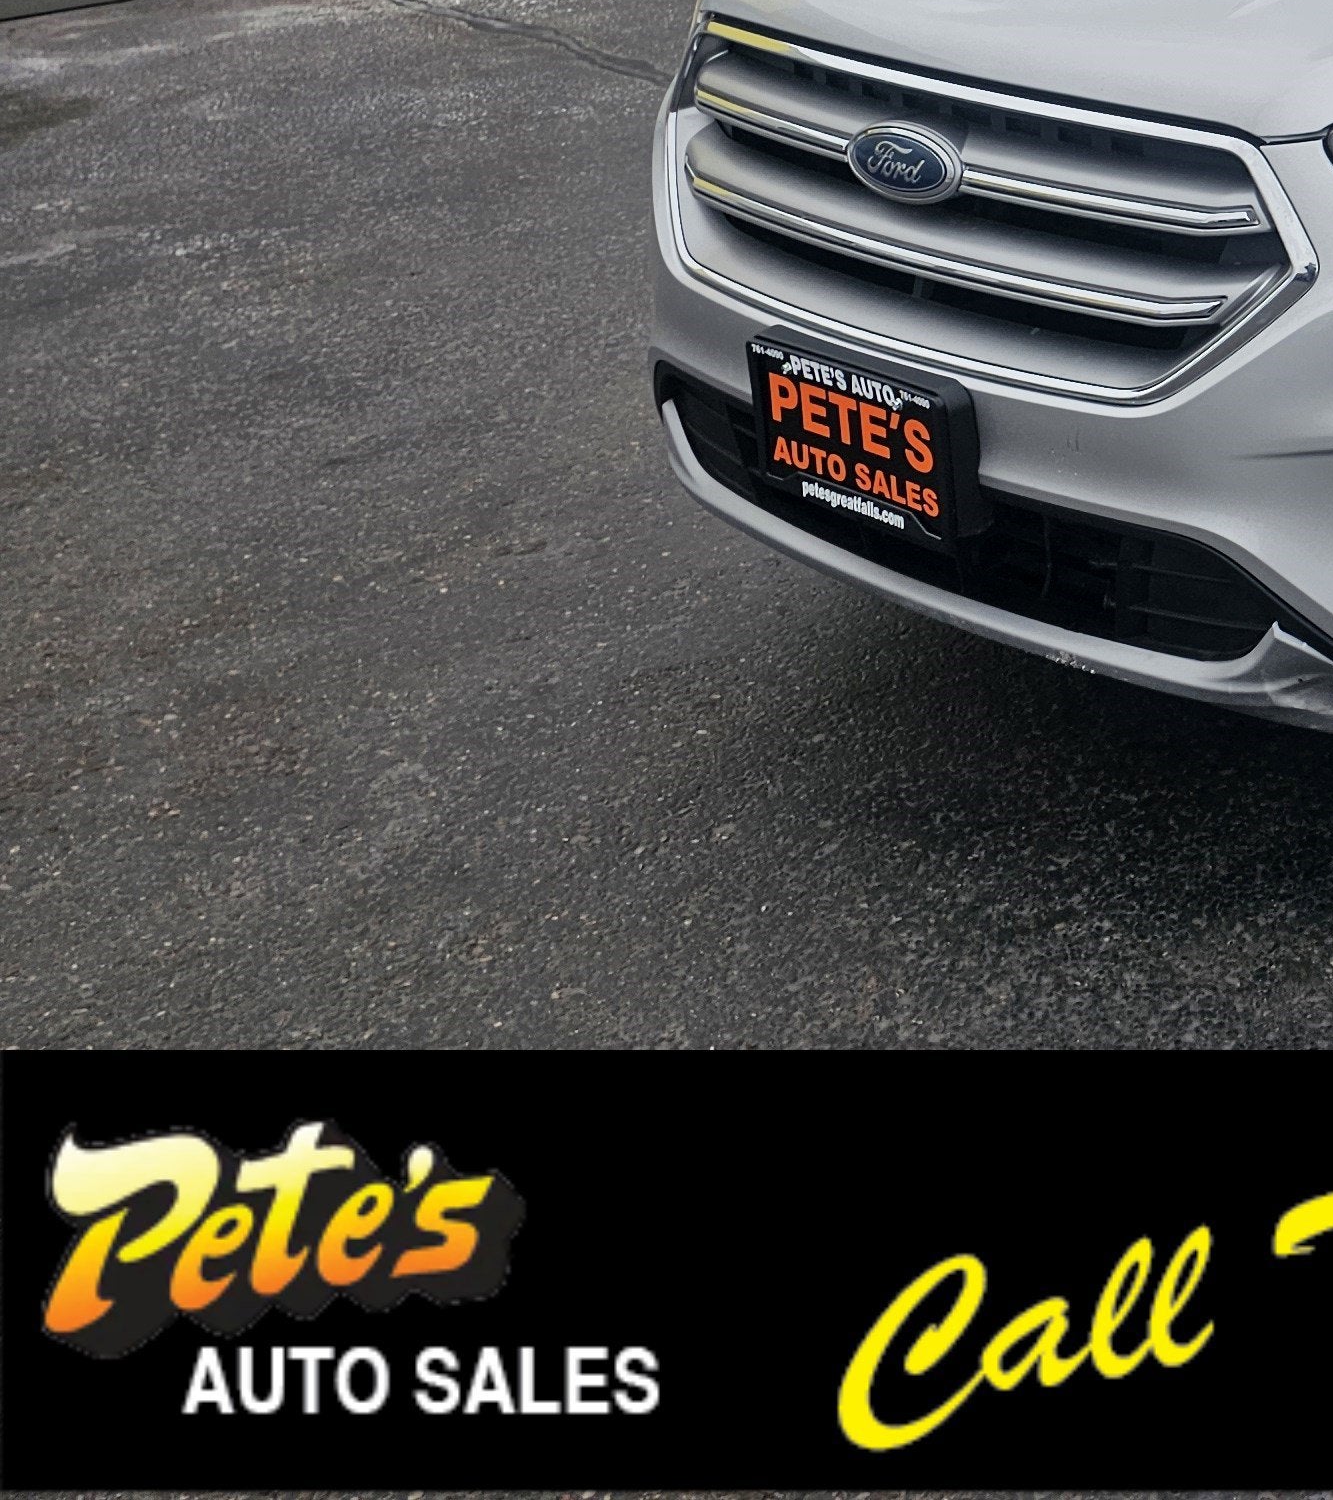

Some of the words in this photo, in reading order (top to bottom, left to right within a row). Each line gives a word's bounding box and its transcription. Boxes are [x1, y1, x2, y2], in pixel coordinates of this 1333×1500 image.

[867, 141, 925, 183] Ford
[790, 354, 848, 391] PETE'S
[851, 374, 896, 408] AUTO
[768, 372, 934, 473] PETE'S
[773, 436, 847, 482] AUTO
[854, 462, 940, 518] SALES
[801, 480, 905, 530] petesgreatfalls.com
